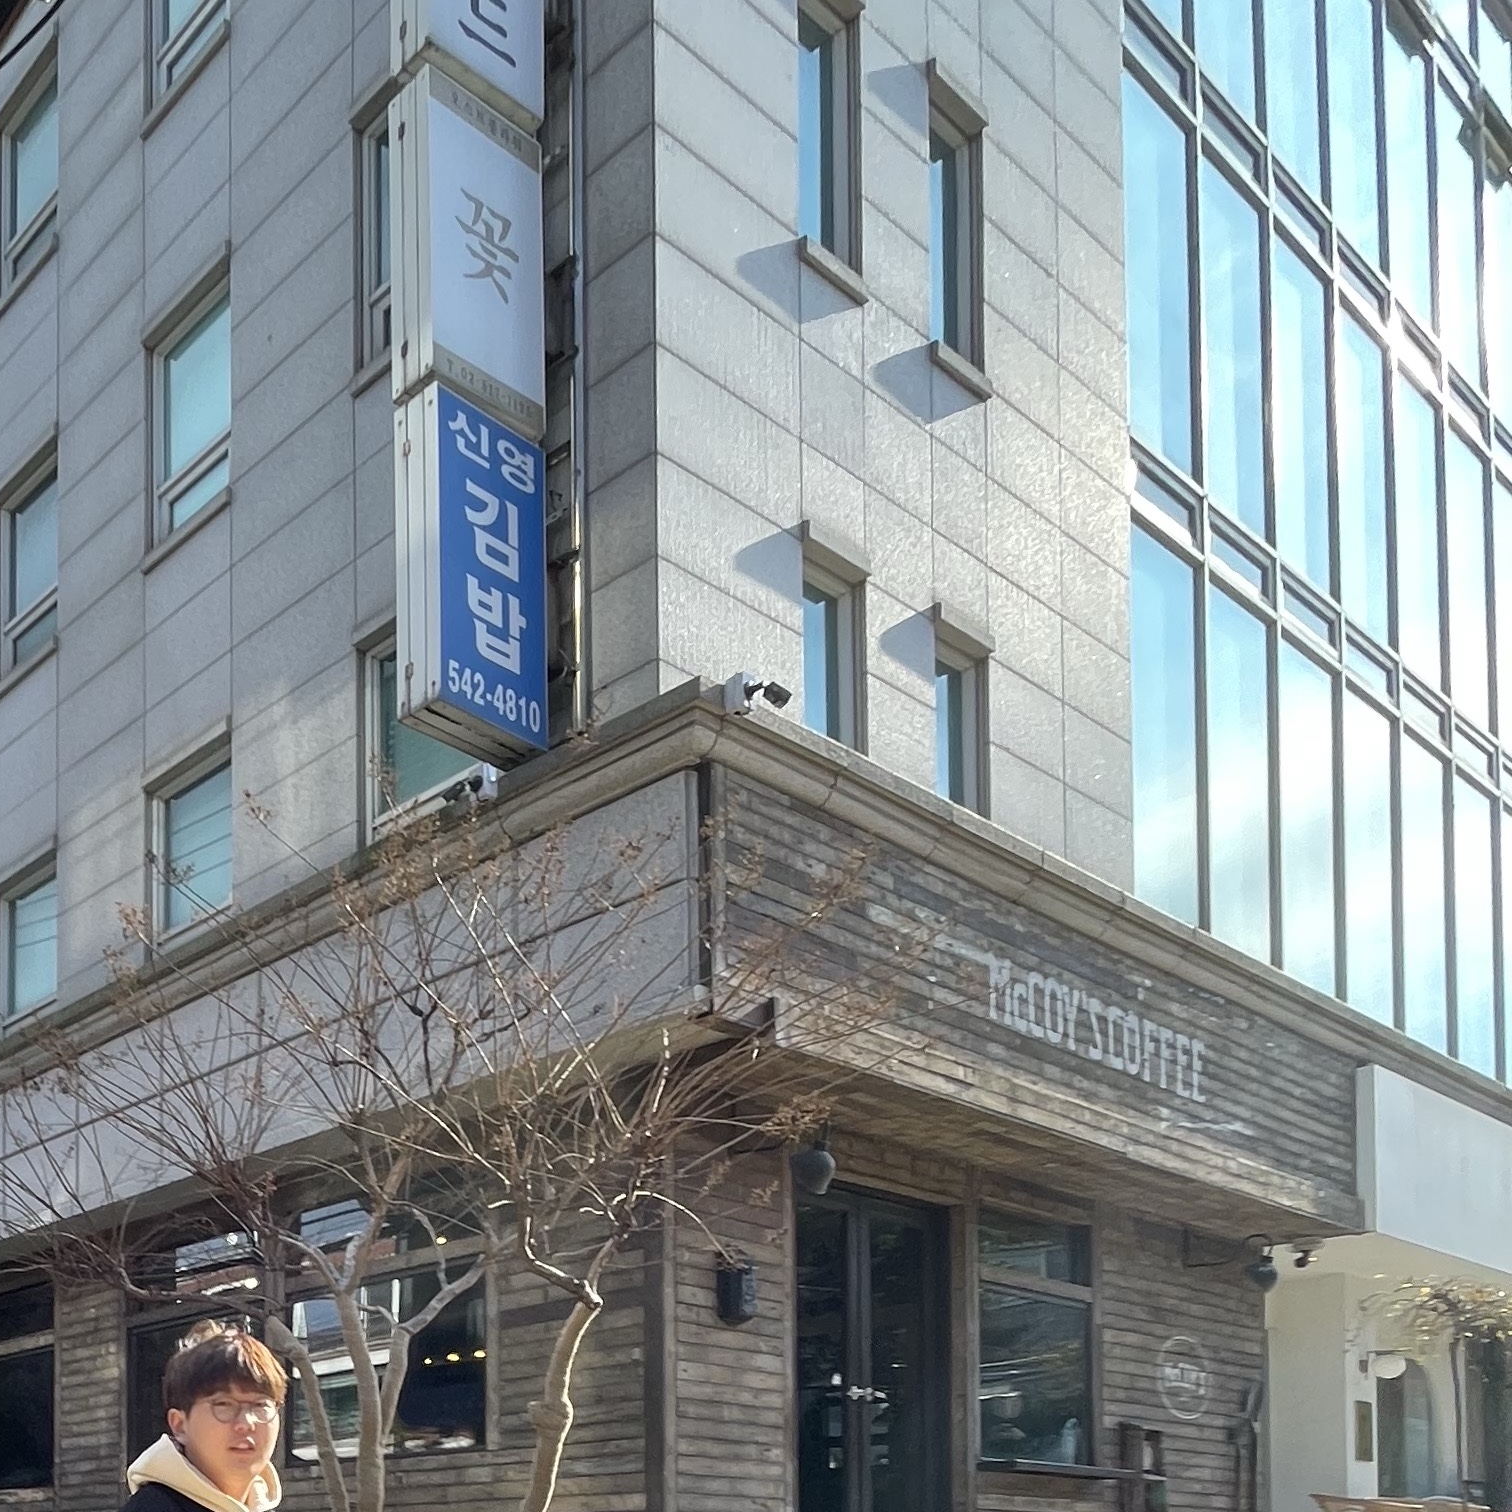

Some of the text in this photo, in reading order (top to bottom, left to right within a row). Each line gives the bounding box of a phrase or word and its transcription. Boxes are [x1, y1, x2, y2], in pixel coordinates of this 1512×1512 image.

[454, 187, 519, 304] 꽃
[448, 410, 535, 494] 신영
[464, 477, 527, 675] 김밥
[448, 659, 540, 733] 542-4810
